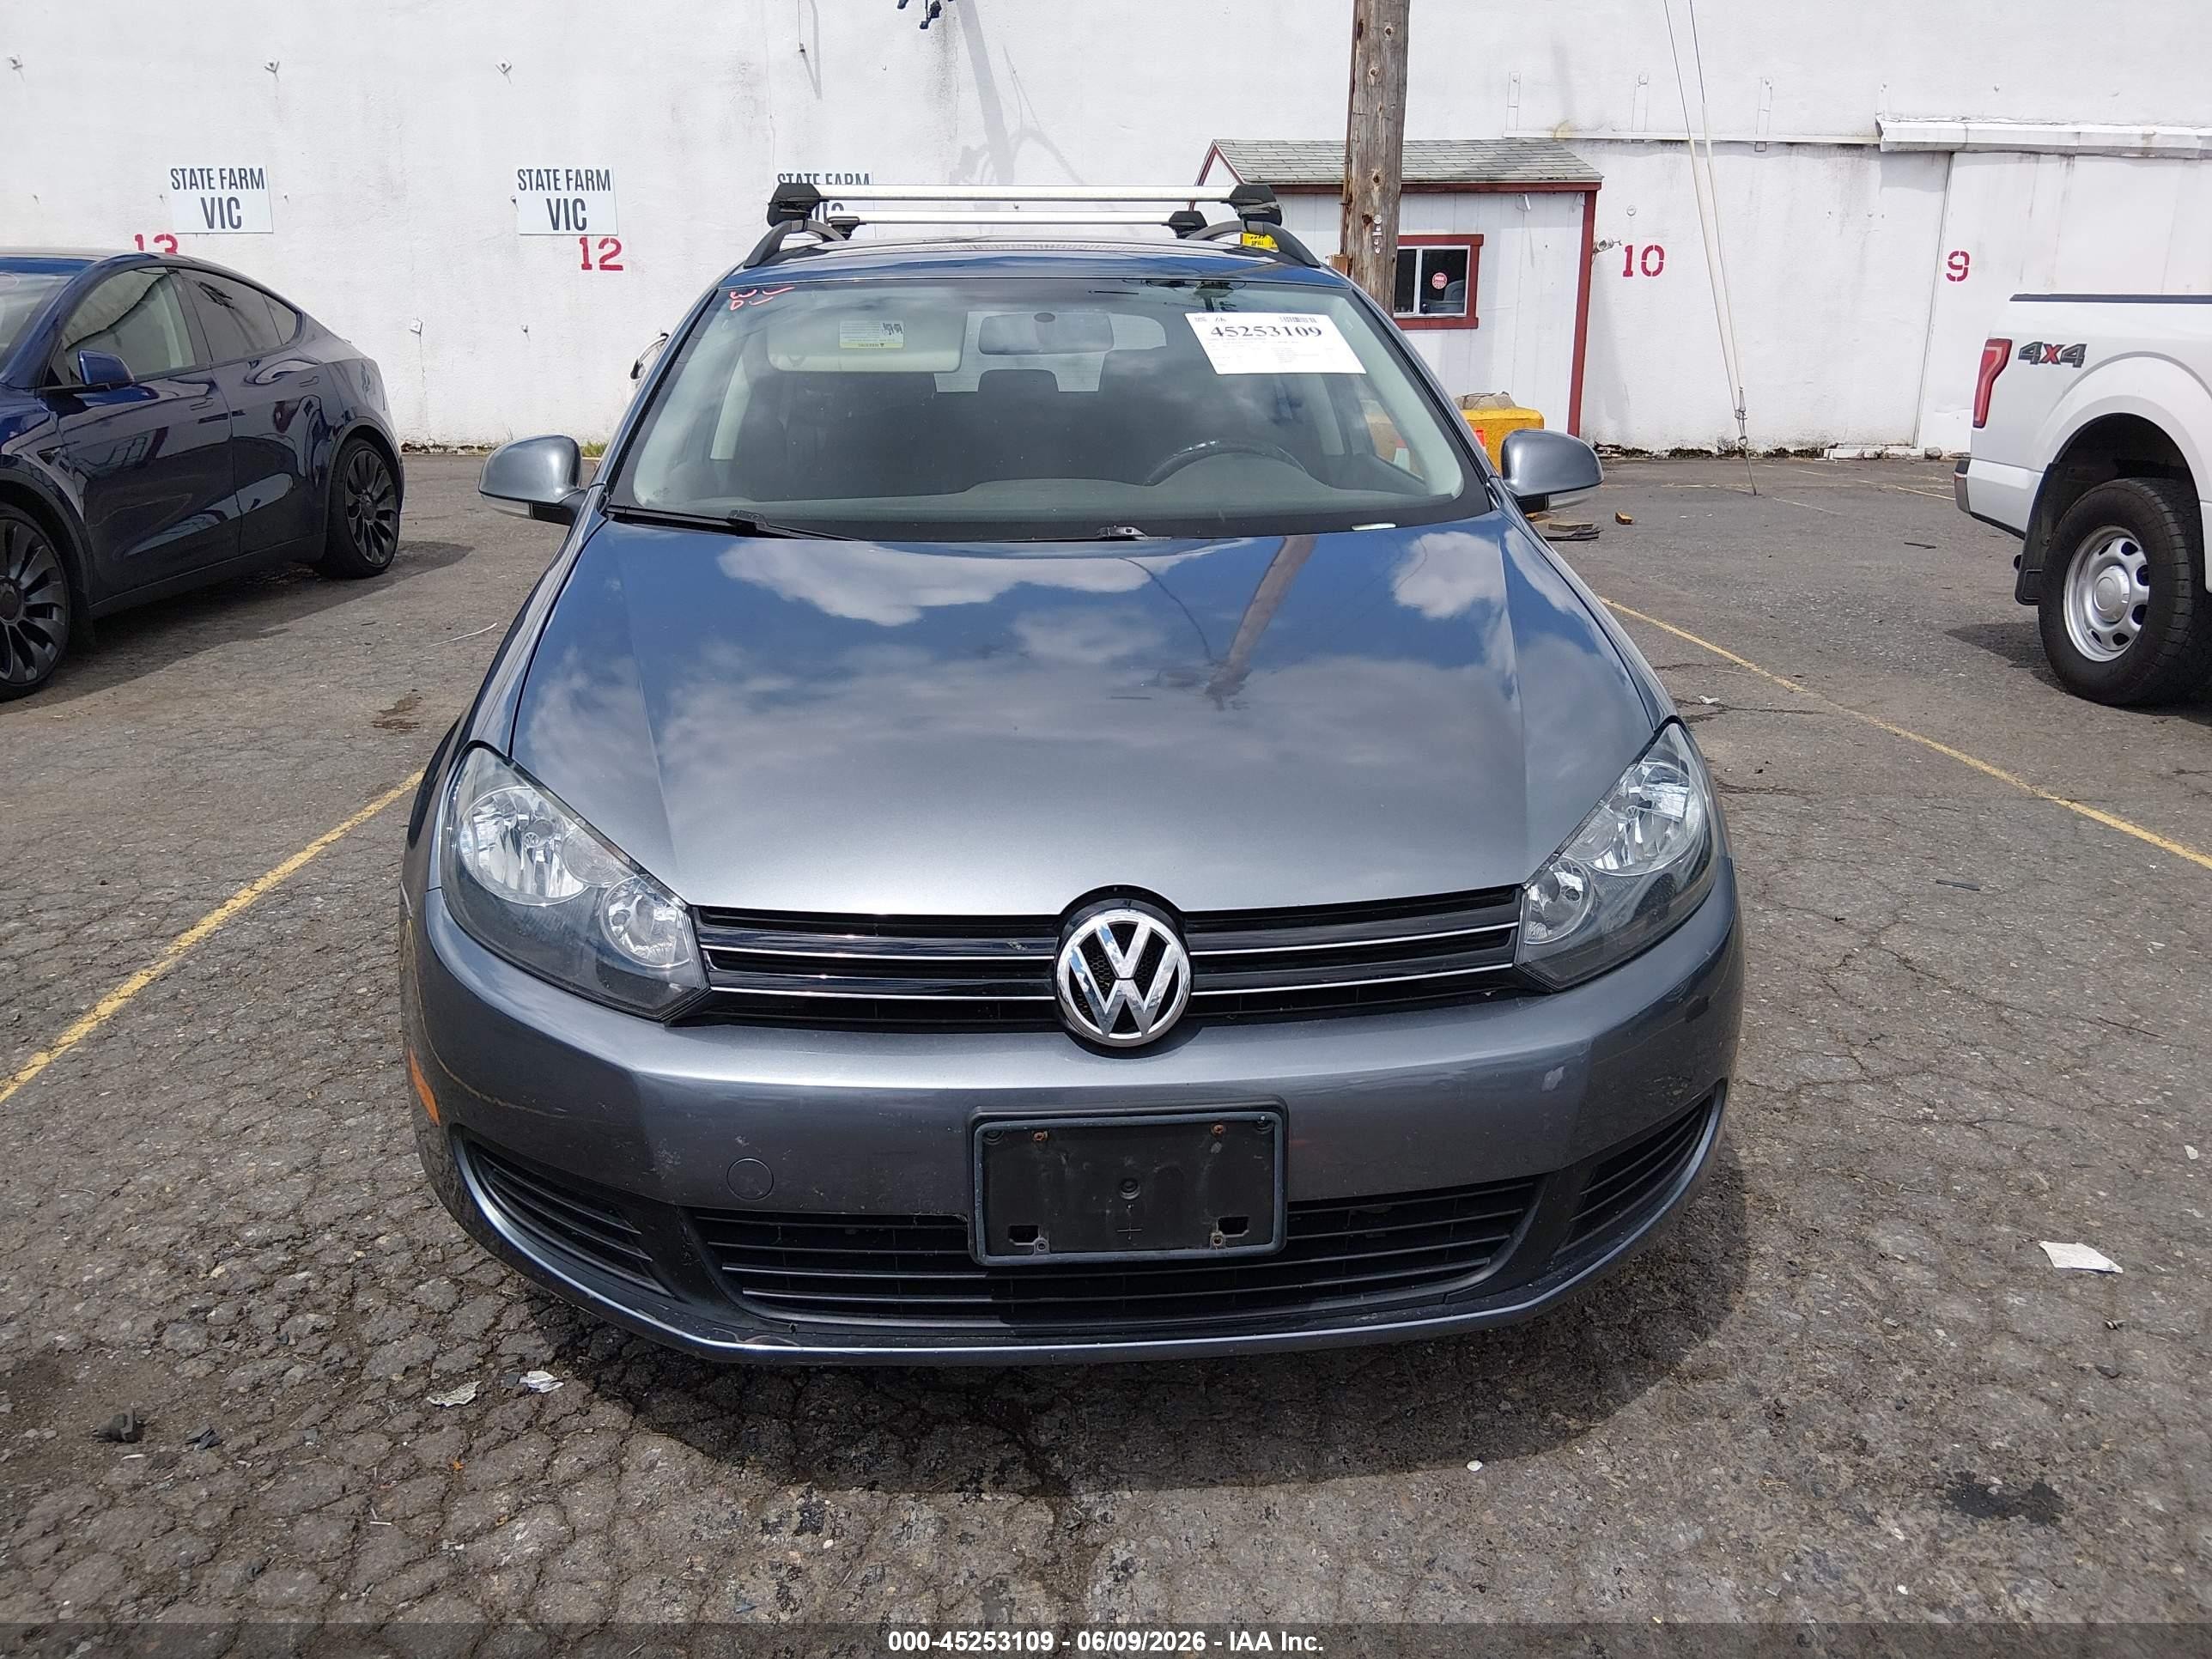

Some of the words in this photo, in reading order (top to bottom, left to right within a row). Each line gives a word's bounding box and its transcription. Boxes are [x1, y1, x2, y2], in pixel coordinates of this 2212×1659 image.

[170, 167, 216, 191] STATE
[219, 167, 265, 190] FARM
[517, 168, 562, 191] STATE
[565, 168, 611, 191] FARM
[200, 197, 242, 229] VIC
[545, 198, 587, 231] VIC
[579, 237, 624, 271] 12
[1622, 245, 1665, 277] 10
[1946, 251, 1970, 282] 9
[1210, 325, 1322, 337] 45253109
[1064, 914, 1185, 1042] VW
